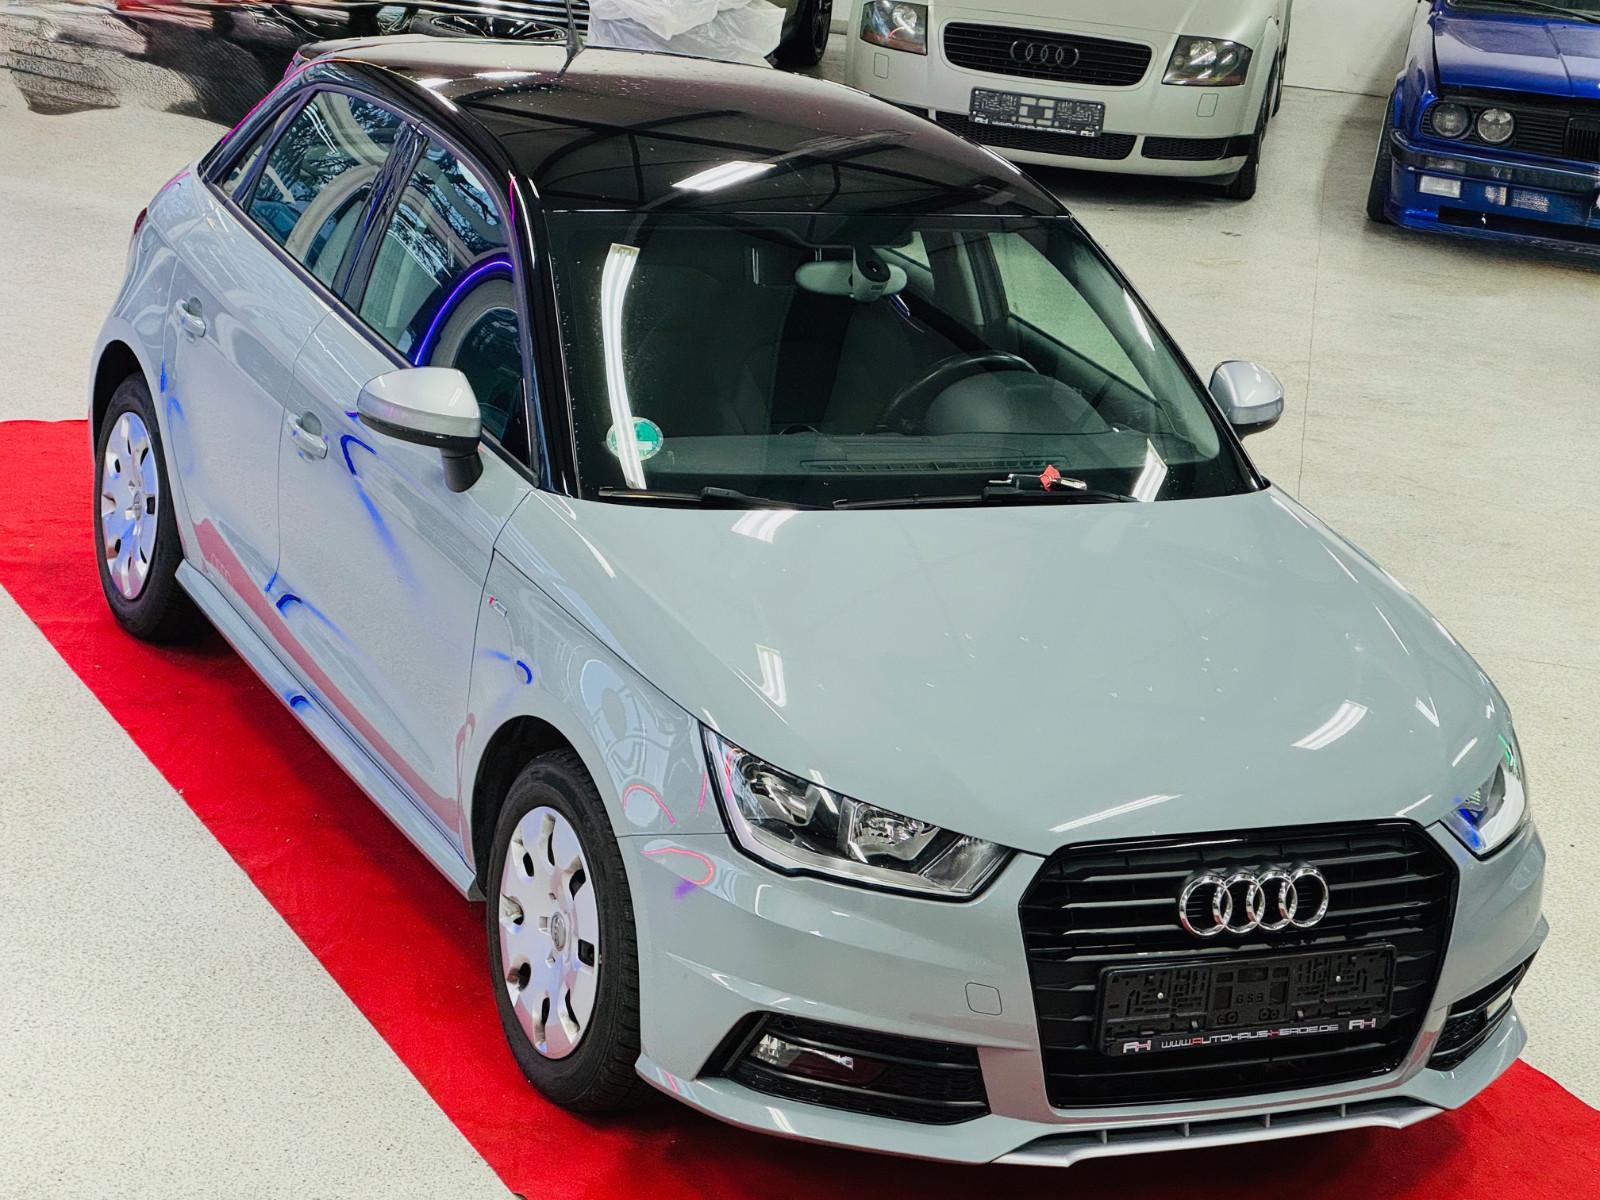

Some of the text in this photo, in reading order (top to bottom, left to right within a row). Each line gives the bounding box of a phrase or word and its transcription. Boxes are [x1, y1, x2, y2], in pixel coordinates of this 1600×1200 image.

[1236, 993, 1264, 1003] GSB
[1123, 1040, 1151, 1053] AH
[1348, 1018, 1376, 1030] AH
